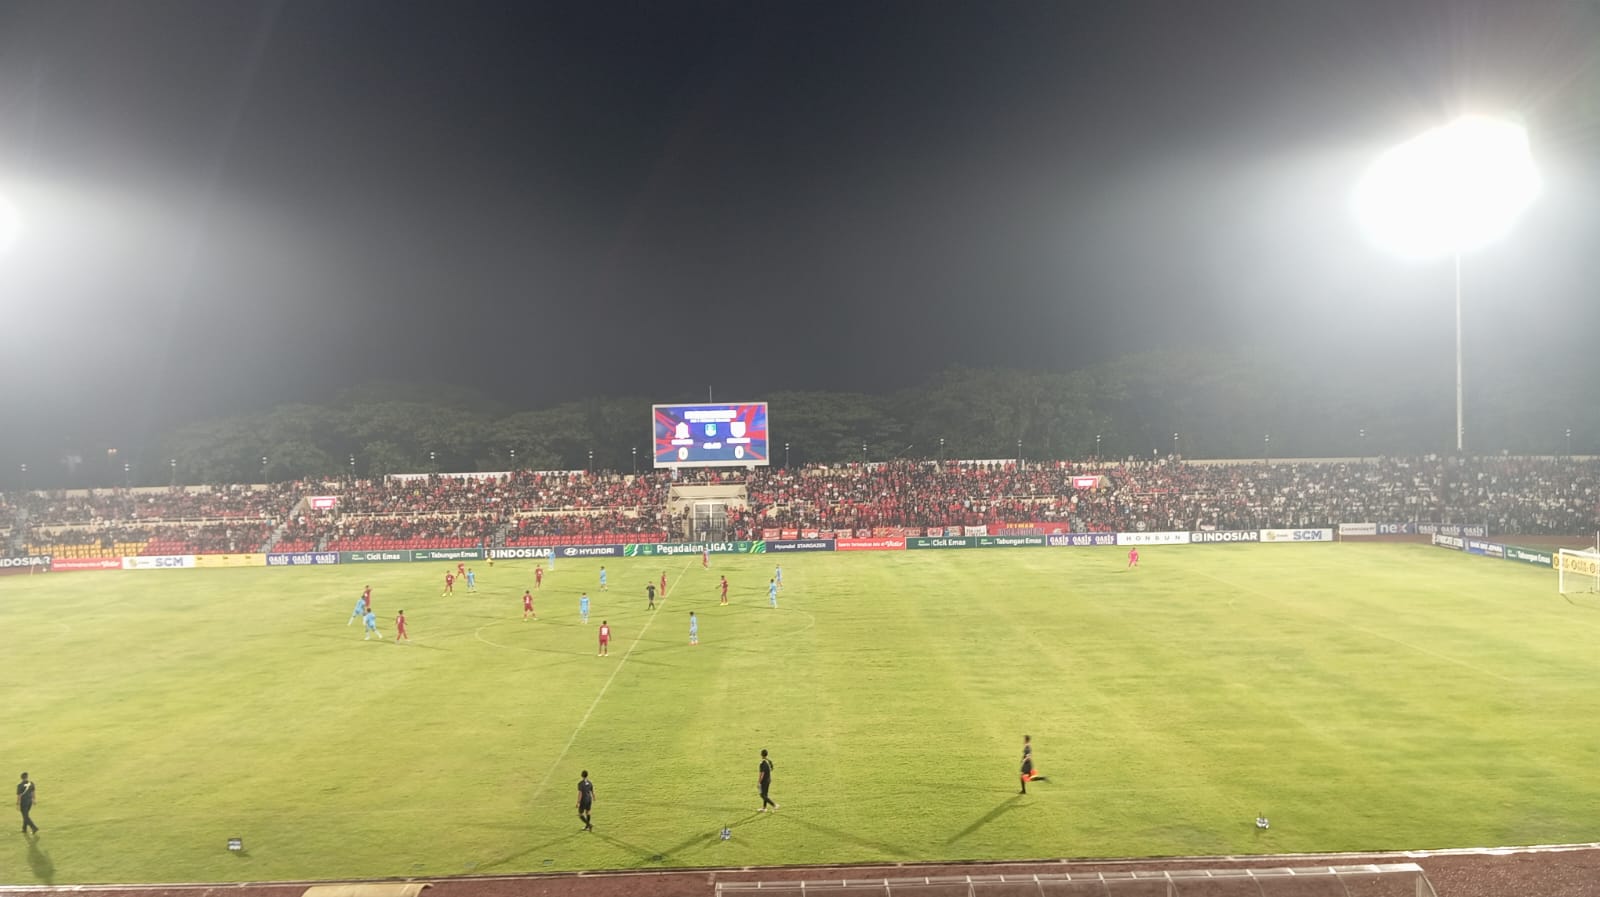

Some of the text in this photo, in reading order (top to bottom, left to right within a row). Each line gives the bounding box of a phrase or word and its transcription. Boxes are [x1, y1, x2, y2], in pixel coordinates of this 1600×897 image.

[1203, 532, 1257, 541] INDOSIAR
[1293, 530, 1322, 540] SCM
[996, 538, 1024, 546] Tabungan
[656, 543, 733, 555] Pegadaian LIGA 2
[155, 557, 184, 567] SCM
